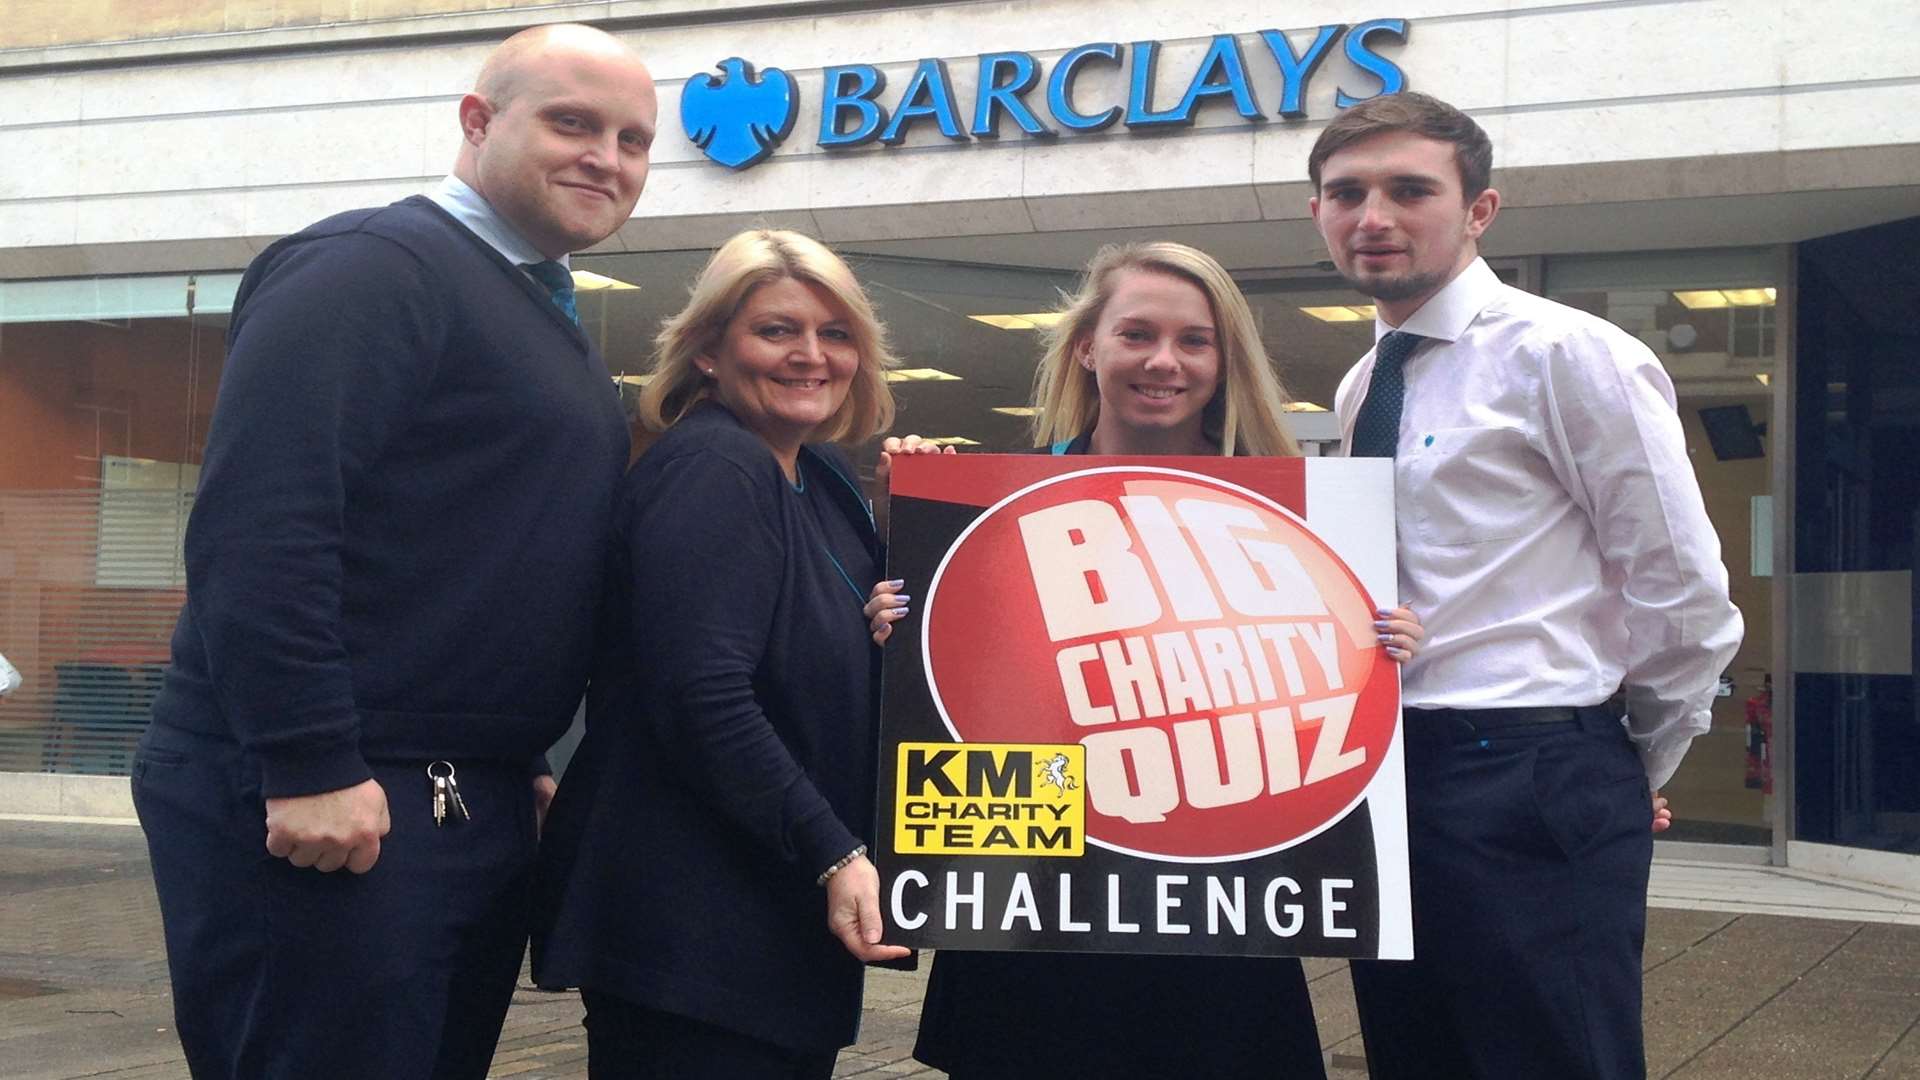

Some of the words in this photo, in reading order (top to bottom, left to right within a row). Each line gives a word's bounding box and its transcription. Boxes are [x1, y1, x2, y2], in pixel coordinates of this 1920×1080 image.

[816, 18, 1408, 149] BARCLAYS
[1018, 495, 1329, 642] BIG
[1056, 622, 1344, 727] CHARITY
[906, 749, 1033, 798] KM
[1078, 693, 1366, 824] QUIZ
[905, 802, 1072, 821] CHARITY
[905, 824, 1072, 850] TEAM
[890, 869, 1358, 938] CHALLENGE
